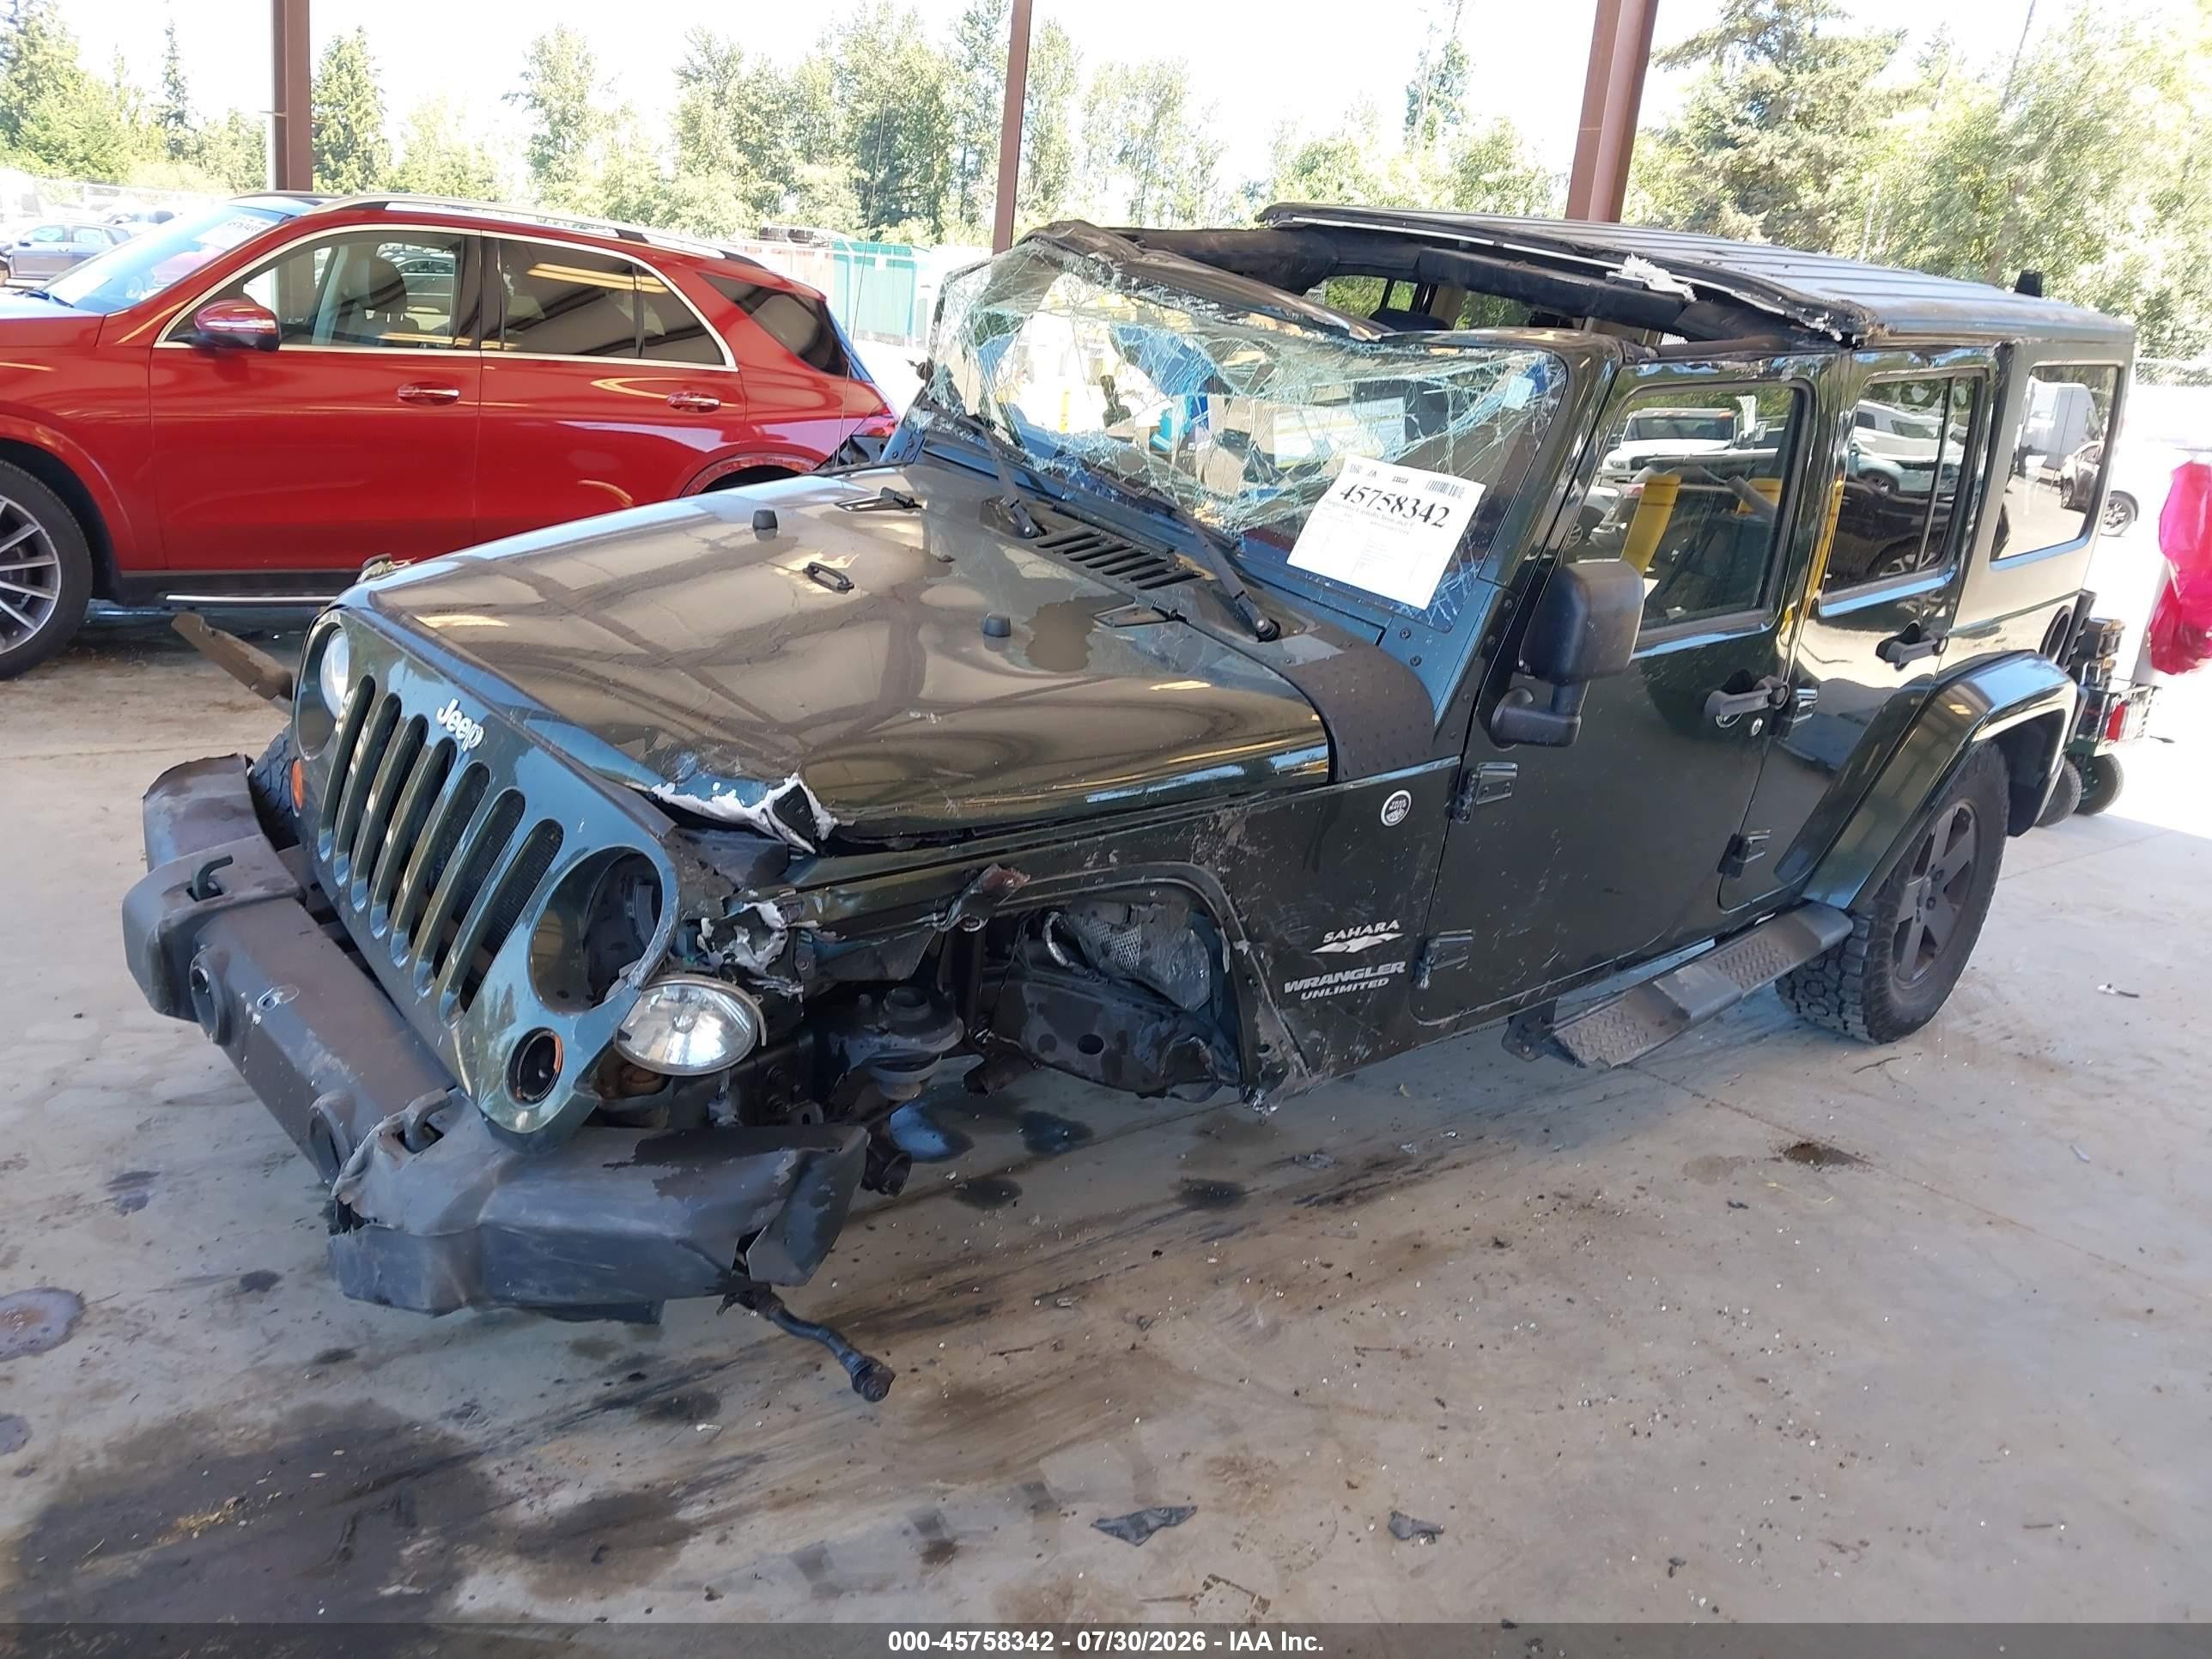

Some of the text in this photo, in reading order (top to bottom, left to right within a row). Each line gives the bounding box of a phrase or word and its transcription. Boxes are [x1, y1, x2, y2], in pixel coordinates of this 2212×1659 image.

[1340, 483, 1451, 528] 45758342
[435, 697, 485, 751] Jeep
[1322, 920, 1401, 943] SAHARA
[1284, 961, 1407, 994] WRANGLER
[1300, 977, 1389, 1000] UNLIMITED
